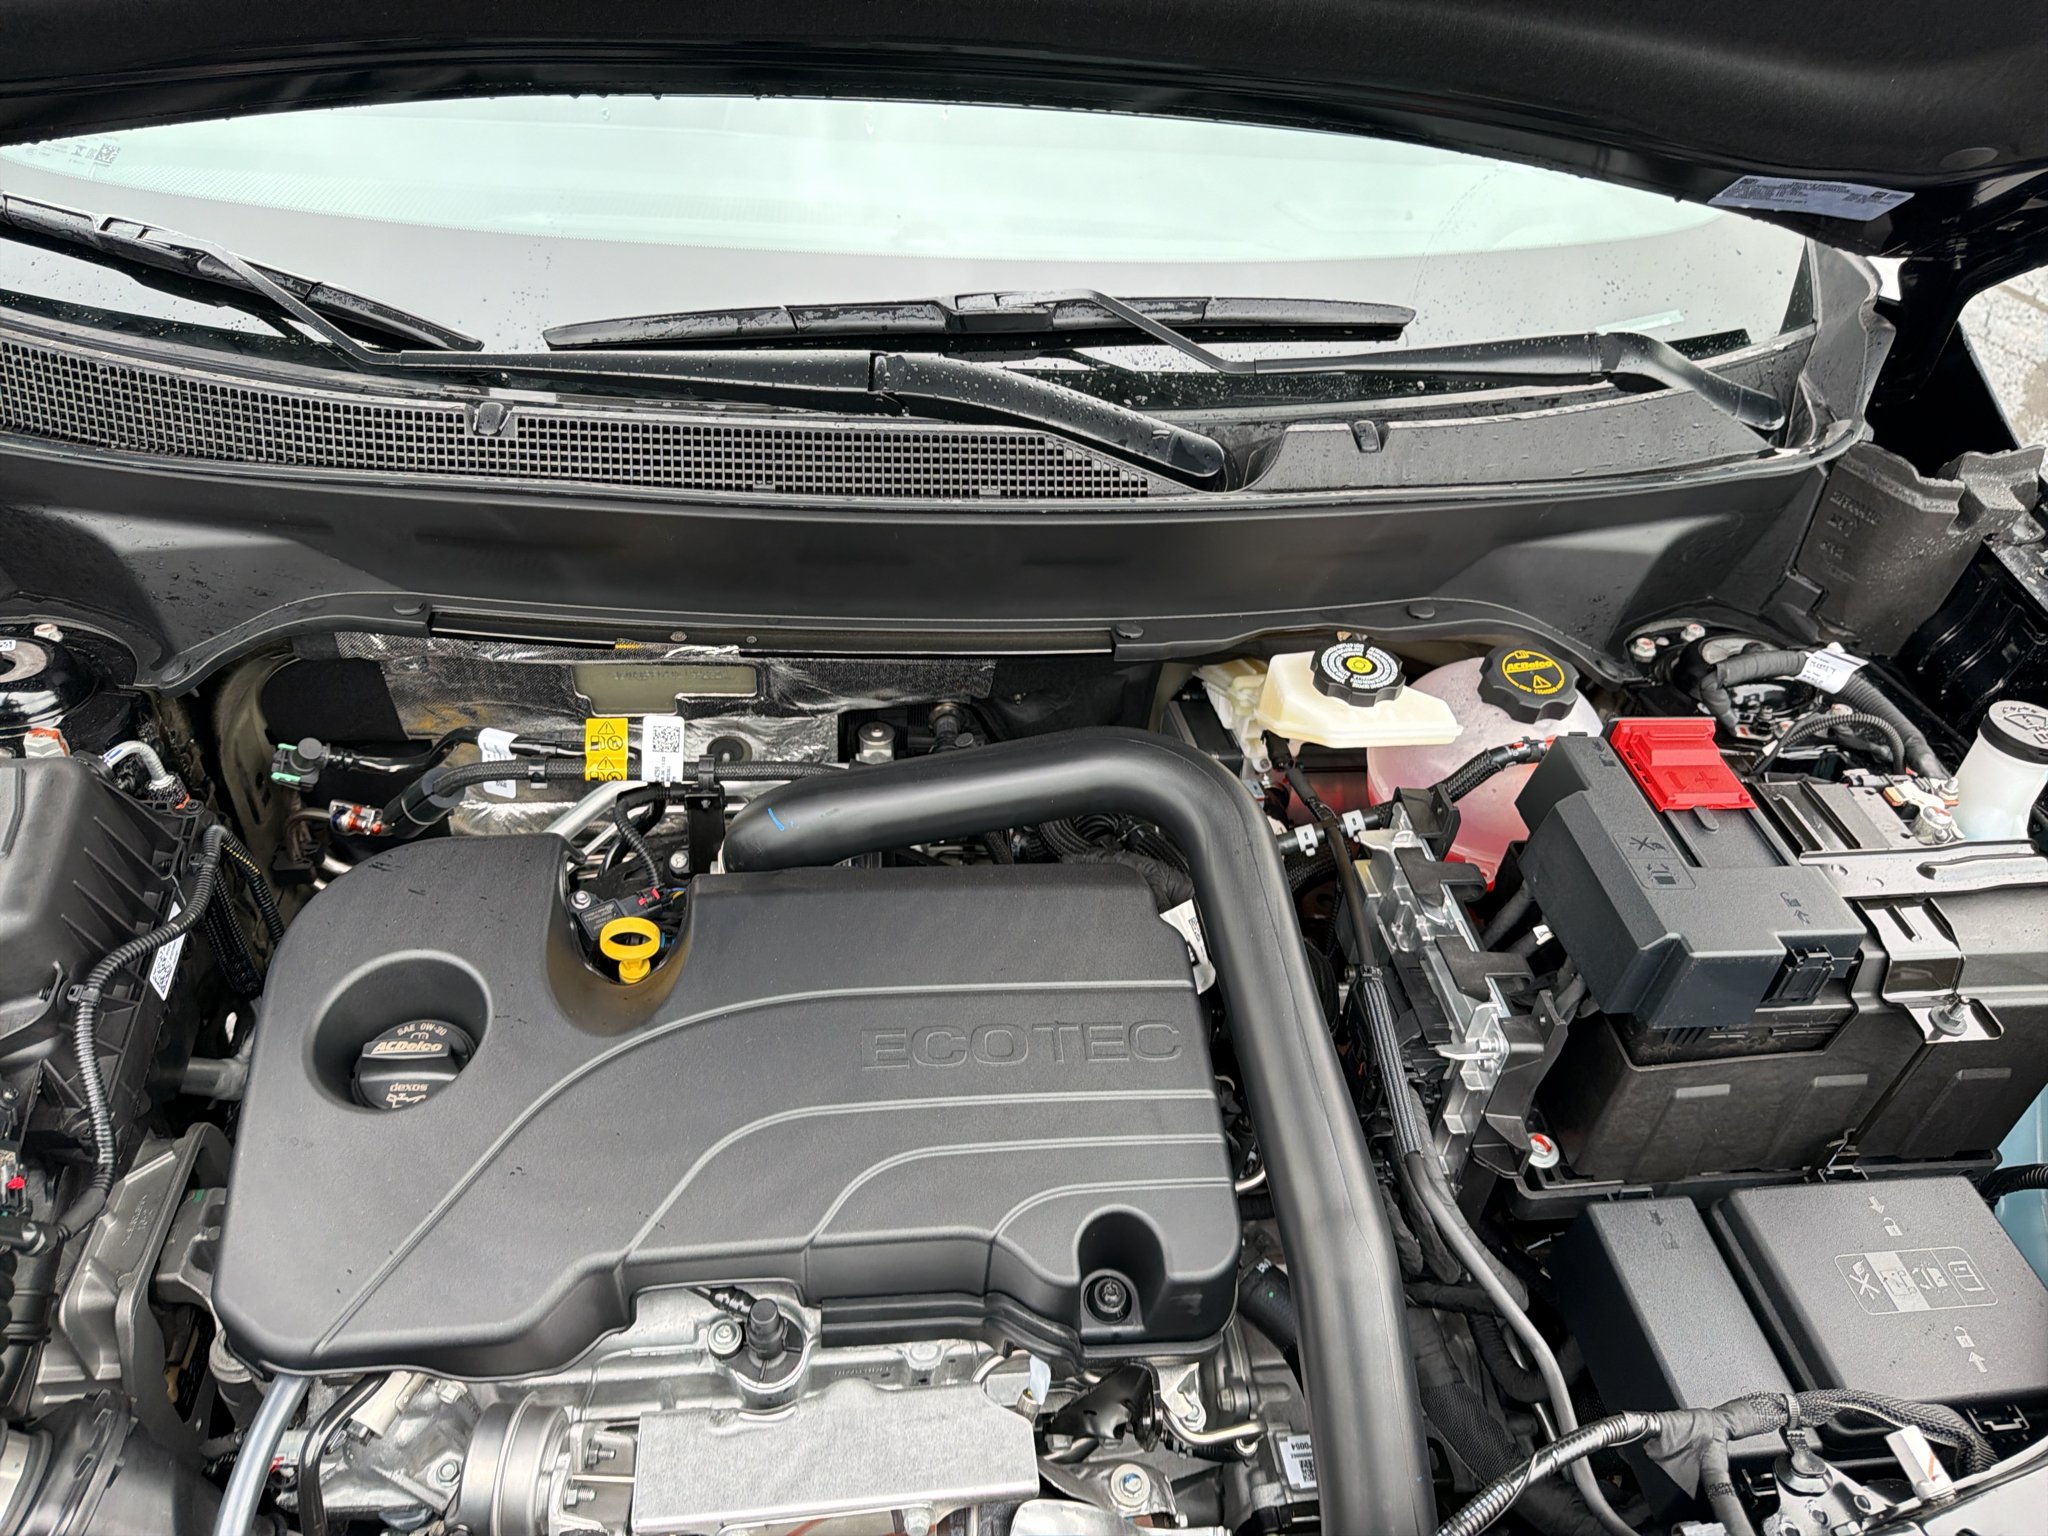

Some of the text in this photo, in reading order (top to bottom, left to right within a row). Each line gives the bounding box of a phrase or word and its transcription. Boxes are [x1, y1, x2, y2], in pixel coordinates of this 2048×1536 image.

[1506, 660, 1553, 672] ACDelco
[397, 1022, 448, 1036] SAE 0W-20
[372, 1041, 443, 1053] ACDelco
[861, 1019, 1182, 1071] ECOTEC
[389, 1082, 429, 1092] dexos
